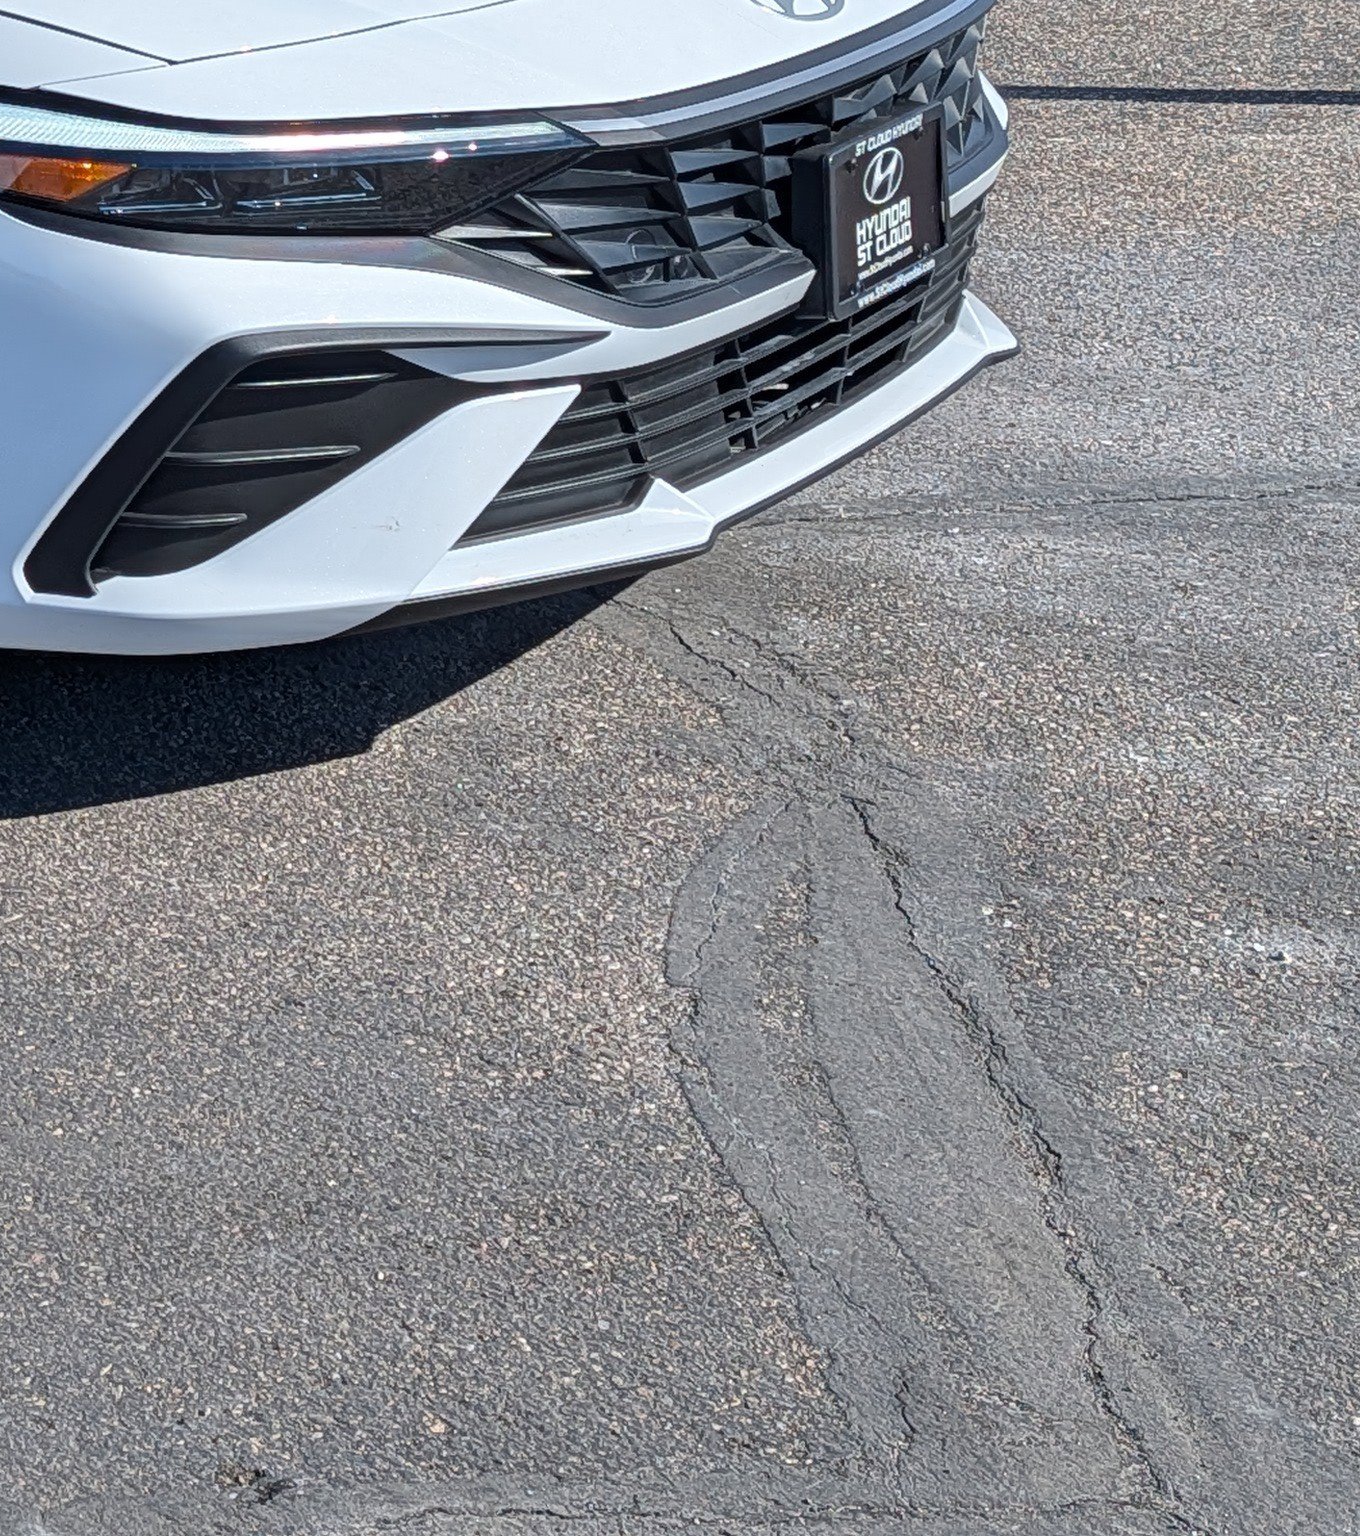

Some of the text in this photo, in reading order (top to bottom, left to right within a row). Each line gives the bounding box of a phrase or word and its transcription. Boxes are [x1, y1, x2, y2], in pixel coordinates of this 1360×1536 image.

[855, 140, 867, 157] ST
[867, 129, 892, 152] CLOUD
[856, 195, 911, 245] HYUNDAI
[857, 220, 913, 267] ST CLOUD
